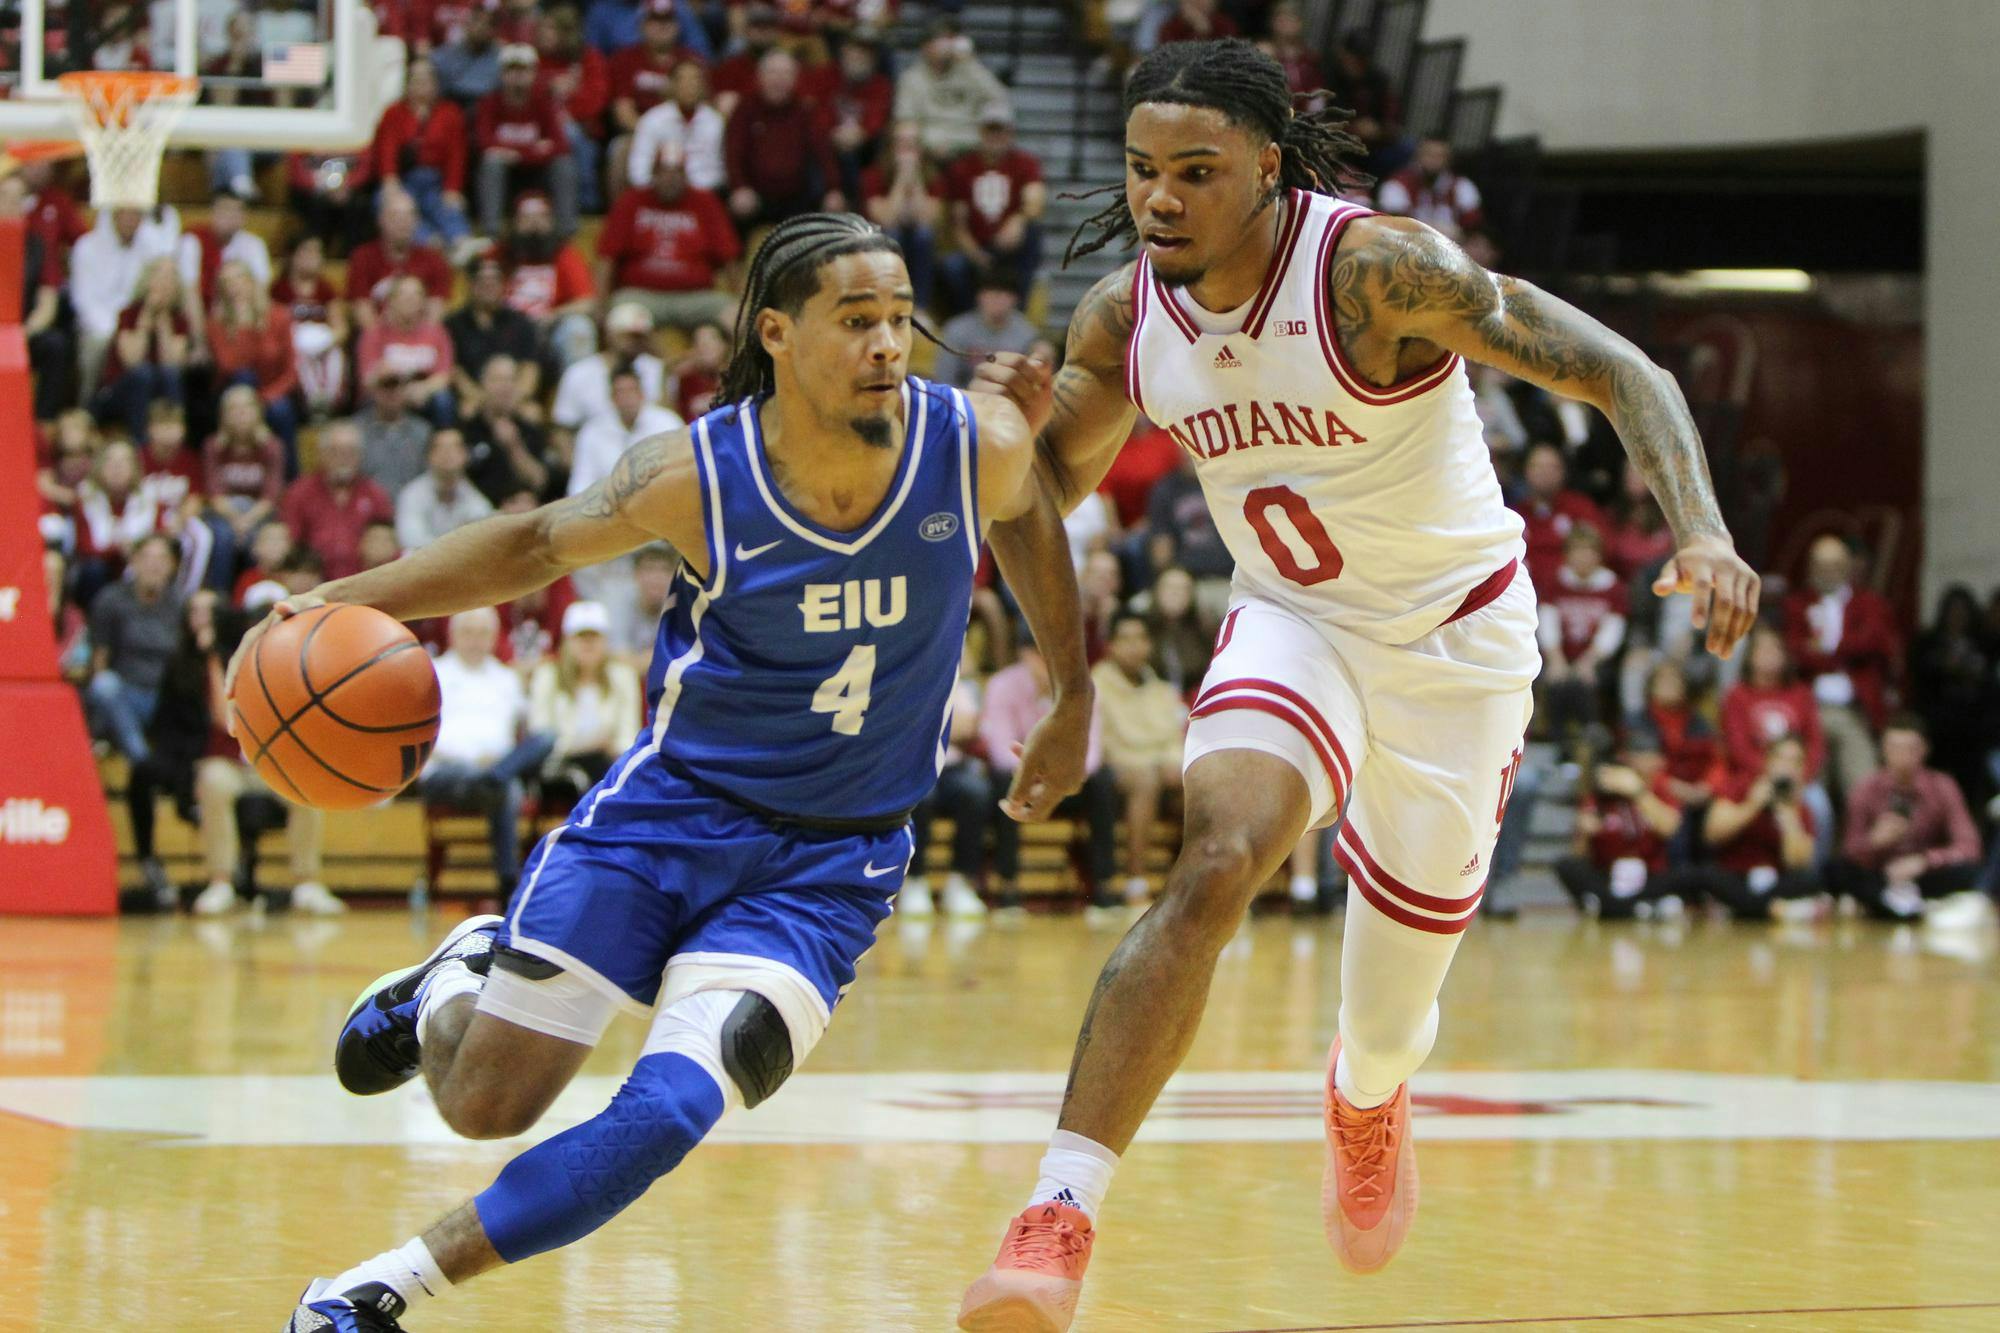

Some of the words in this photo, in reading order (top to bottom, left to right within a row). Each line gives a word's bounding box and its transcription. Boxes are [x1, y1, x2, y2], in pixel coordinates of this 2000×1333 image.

[1213, 359, 1242, 368] adidas
[1169, 401, 1367, 459] NDIANA
[798, 575, 907, 633] EIU
[810, 644, 876, 736] 4
